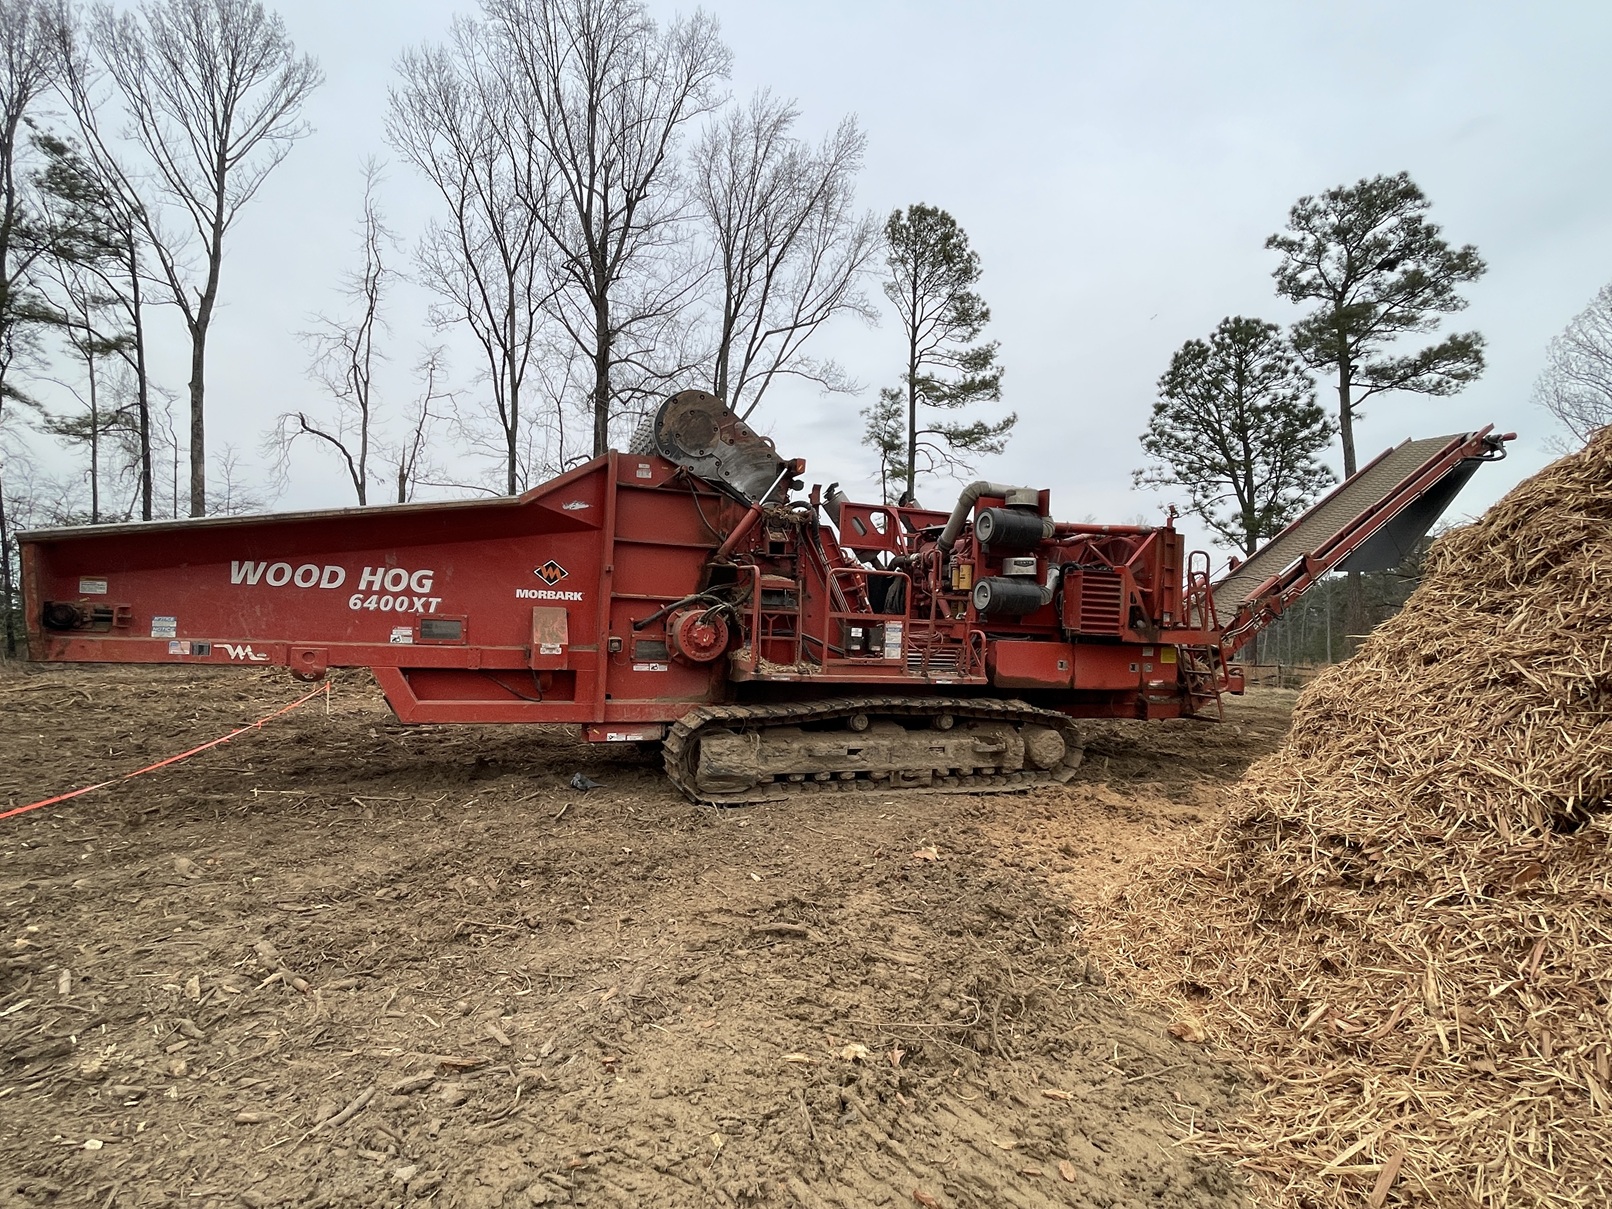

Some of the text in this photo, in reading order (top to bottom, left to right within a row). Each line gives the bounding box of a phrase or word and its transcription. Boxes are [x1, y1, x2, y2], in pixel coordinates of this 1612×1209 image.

[230, 560, 434, 593] WOOD HOG
[348, 593, 442, 613] 6400XT
[515, 588, 583, 601] MORBARK
